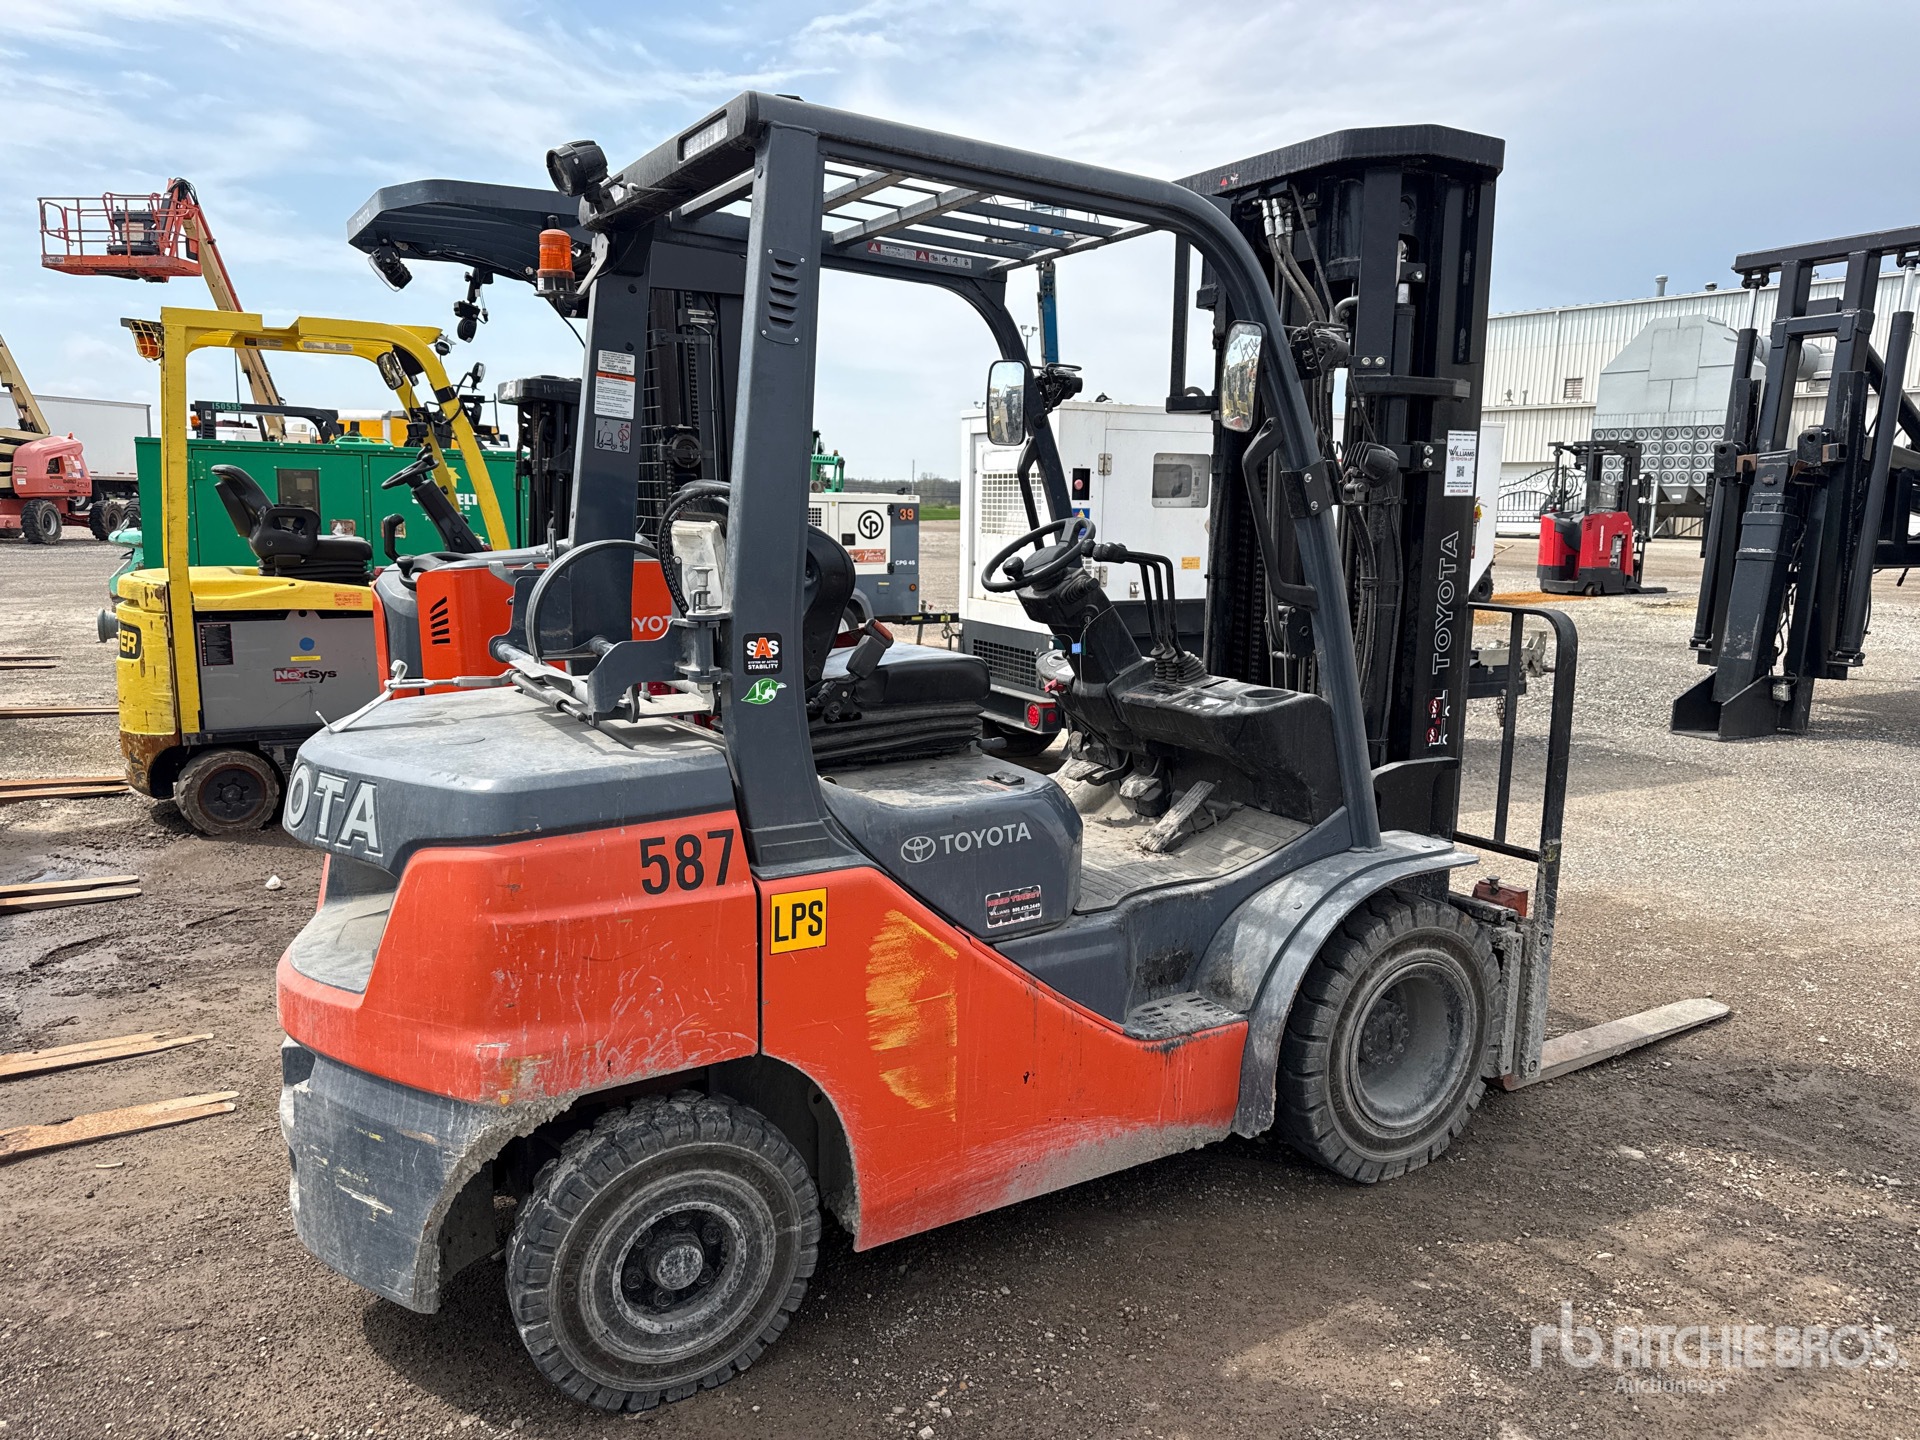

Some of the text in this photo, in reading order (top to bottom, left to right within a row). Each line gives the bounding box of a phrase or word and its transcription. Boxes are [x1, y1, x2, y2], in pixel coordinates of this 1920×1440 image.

[211, 402, 243, 411] 150595
[1448, 446, 1475, 457] WILLIAMS
[899, 508, 914, 520] 39
[1432, 531, 1459, 675] TOYOTA
[746, 637, 780, 659] SAS
[275, 669, 338, 683] NexSys
[940, 822, 1032, 855] TOYOTA
[640, 828, 734, 895] 587
[774, 900, 823, 942] LPS
